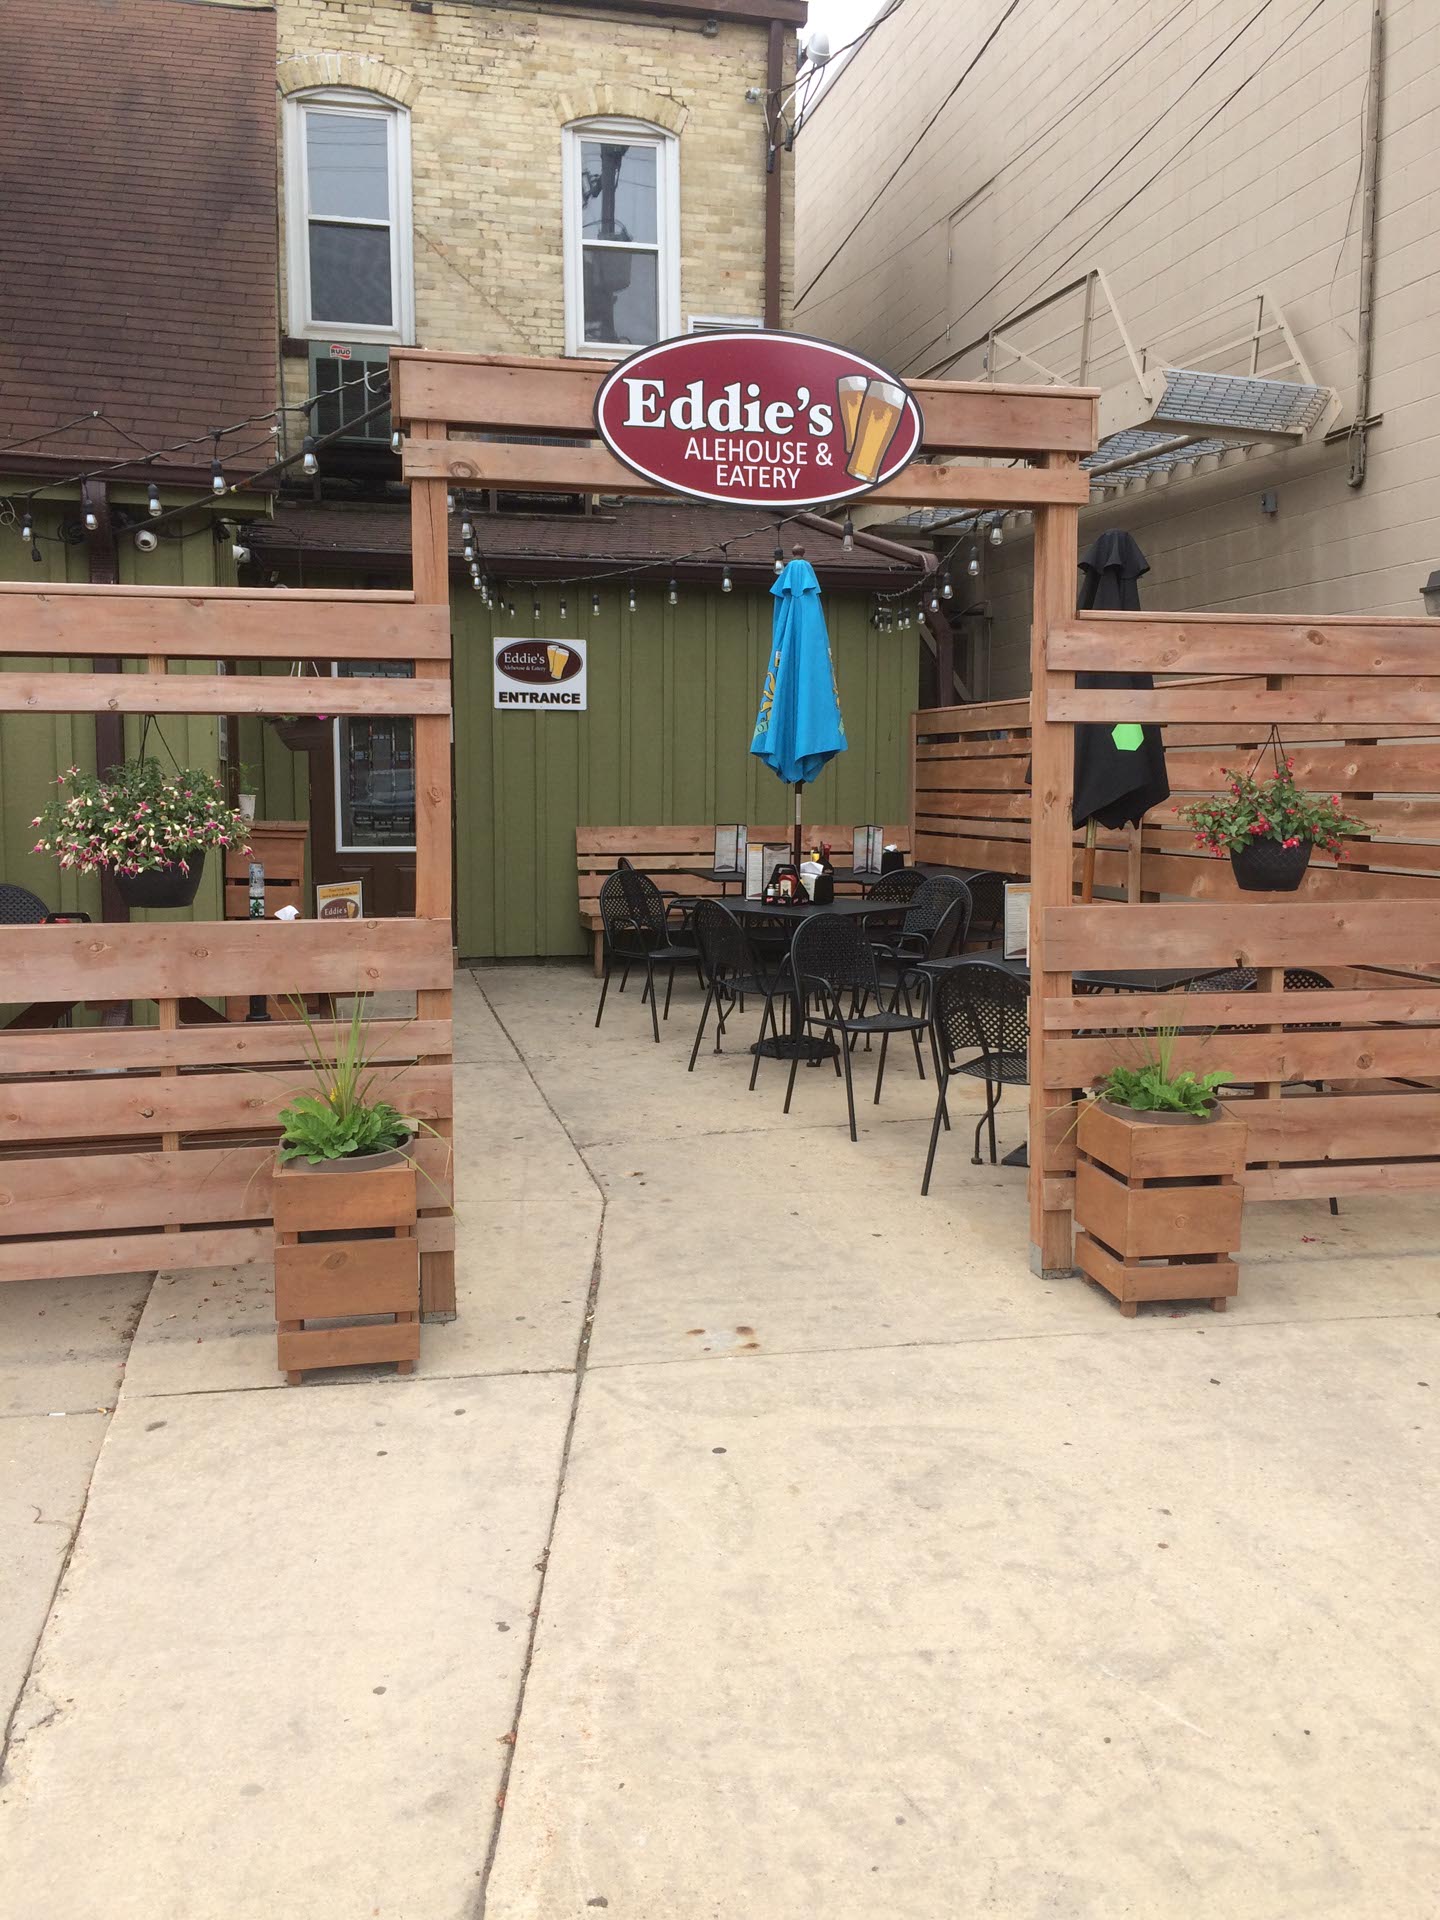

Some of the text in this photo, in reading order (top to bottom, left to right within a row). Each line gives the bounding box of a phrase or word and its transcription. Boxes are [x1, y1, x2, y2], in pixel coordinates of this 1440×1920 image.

[622, 377, 834, 437] Eddie's
[684, 437, 834, 466] ALEHOUSE &
[715, 464, 801, 489] EATERY
[503, 652, 546, 665] Eddie's
[498, 691, 581, 704] ENTRANCE
